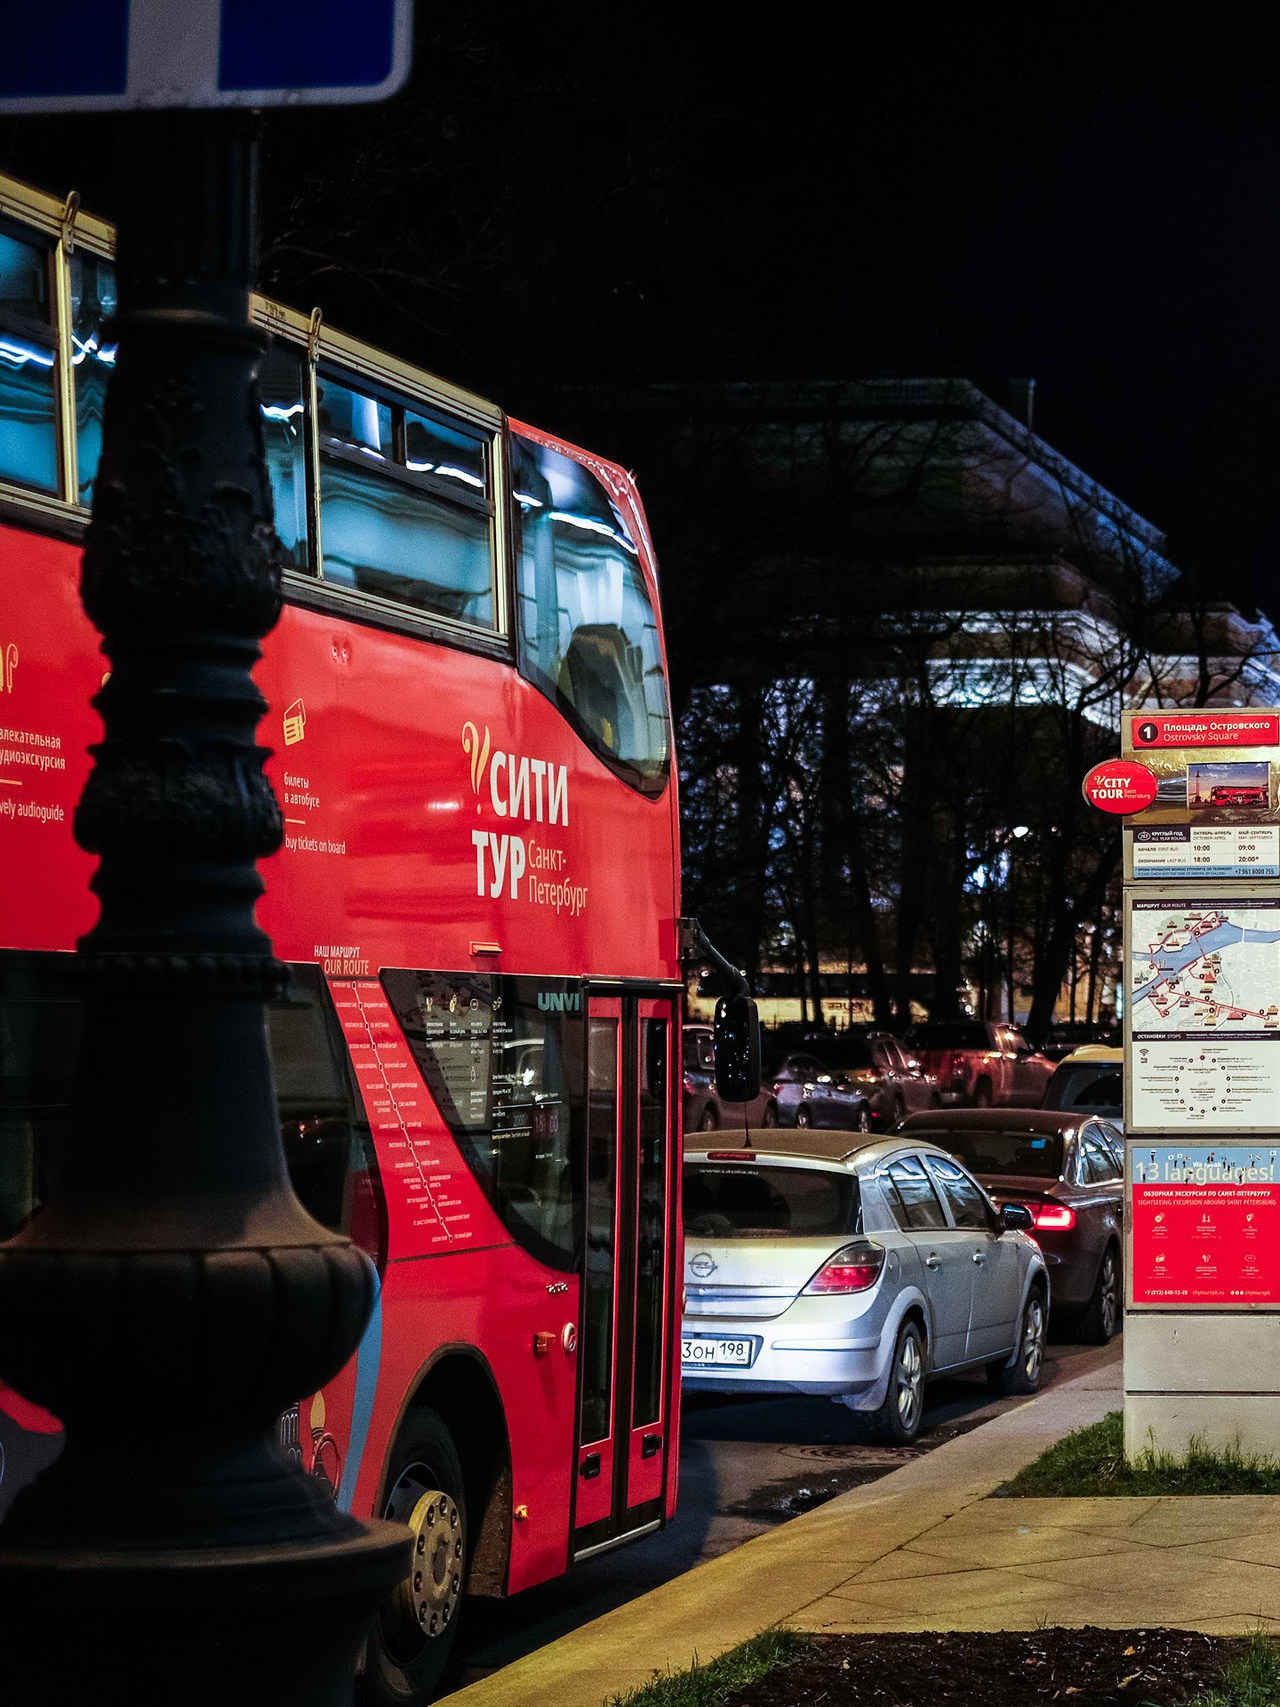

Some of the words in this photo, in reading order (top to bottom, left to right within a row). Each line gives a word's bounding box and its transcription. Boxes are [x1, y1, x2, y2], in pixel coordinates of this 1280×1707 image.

[1142, 726, 1151, 739] 1
[1163, 723, 1208, 733] Площадь
[1209, 722, 1271, 732] Островского
[1163, 732, 1206, 743] Ostrovsky
[1207, 732, 1239, 742] Square
[284, 771, 310, 789] билеты
[490, 750, 569, 827] СИТИ
[1103, 777, 1131, 788] CITY
[284, 793, 289, 803] в
[290, 793, 320, 810] автобусе
[1091, 788, 1124, 800] TOUR
[17, 801, 65, 824] audioguide
[285, 833, 298, 853] buy
[298, 835, 318, 852] tickets
[318, 841, 328, 853] on
[328, 839, 346, 855] board
[471, 829, 526, 900] ТУР
[528, 839, 567, 872] Санкт-
[529, 875, 589, 917] Петербург
[314, 945, 329, 957] НАШ
[330, 946, 361, 958] МАРШРУТ
[324, 959, 343, 974] OUR
[344, 960, 369, 975] ROUTE
[537, 992, 580, 1012] UNVI
[1135, 1162, 1159, 1181] 13
[1164, 1162, 1275, 1186] languages!
[719, 1342, 744, 1357] 198
